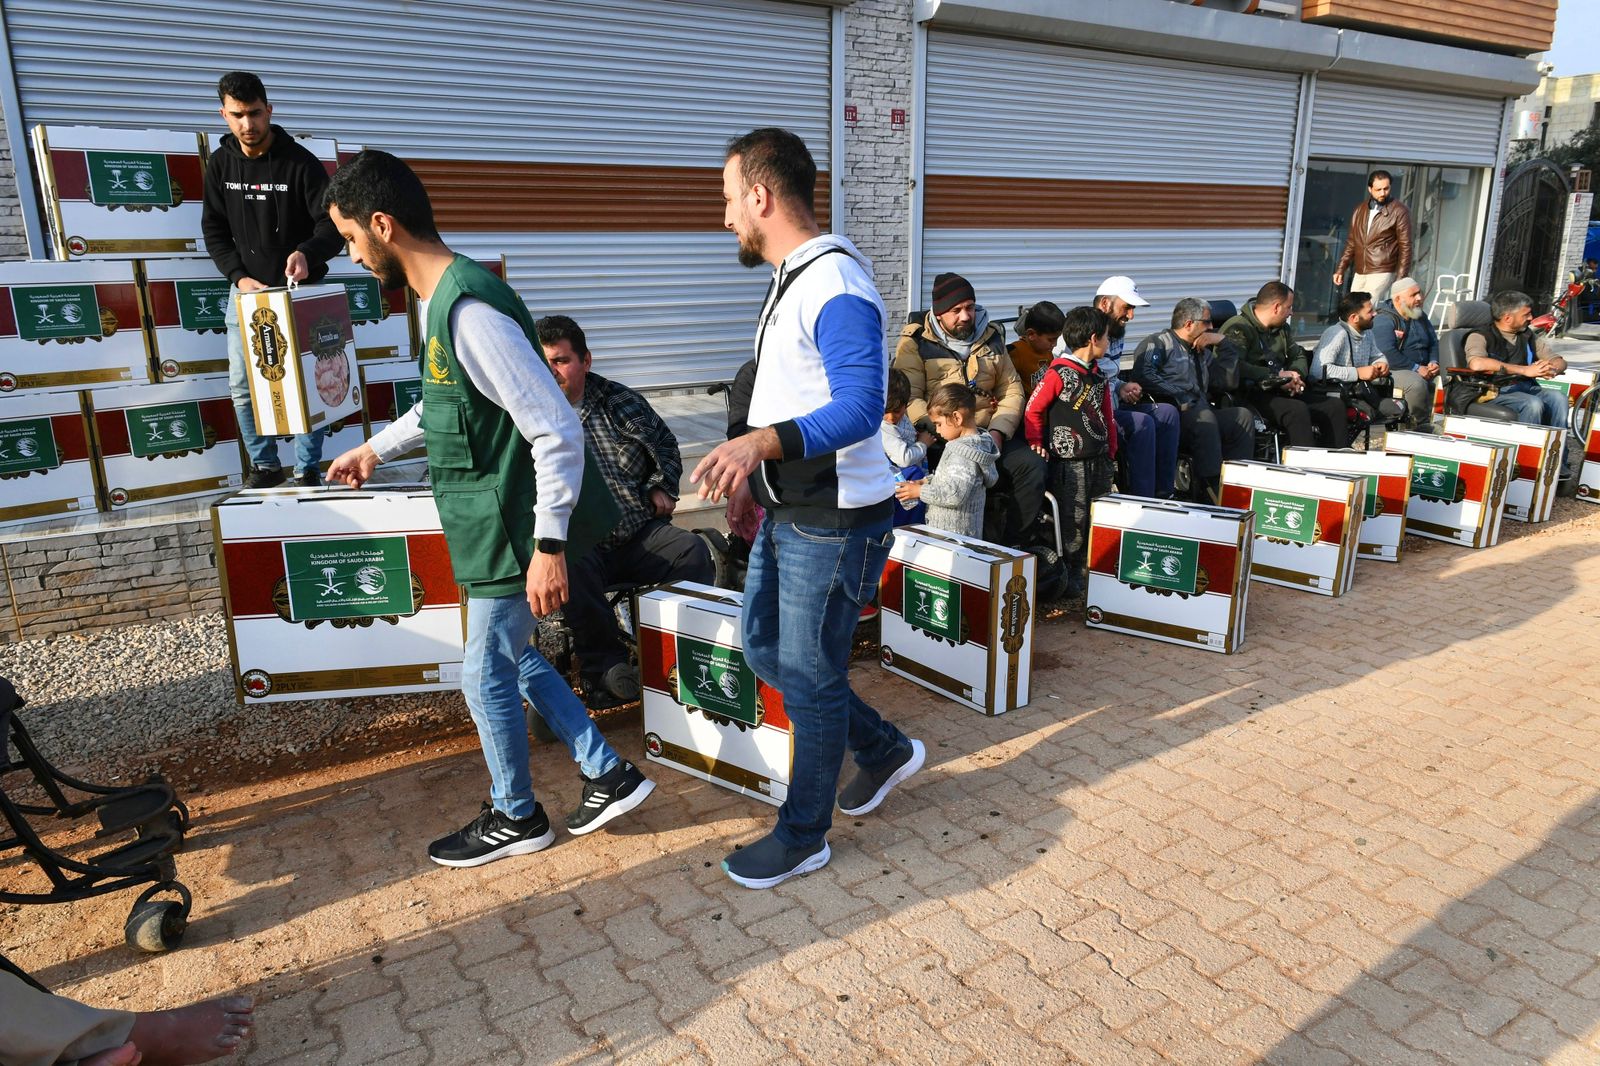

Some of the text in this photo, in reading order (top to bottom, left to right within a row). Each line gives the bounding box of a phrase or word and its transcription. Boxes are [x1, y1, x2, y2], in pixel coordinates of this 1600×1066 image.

[262, 324, 274, 355] Armada
[272, 391, 282, 408] 2PLY
[1072, 384, 1091, 410] VERSACE
[1012, 594, 1020, 625] Armada
[276, 683, 296, 691] 2PLY
